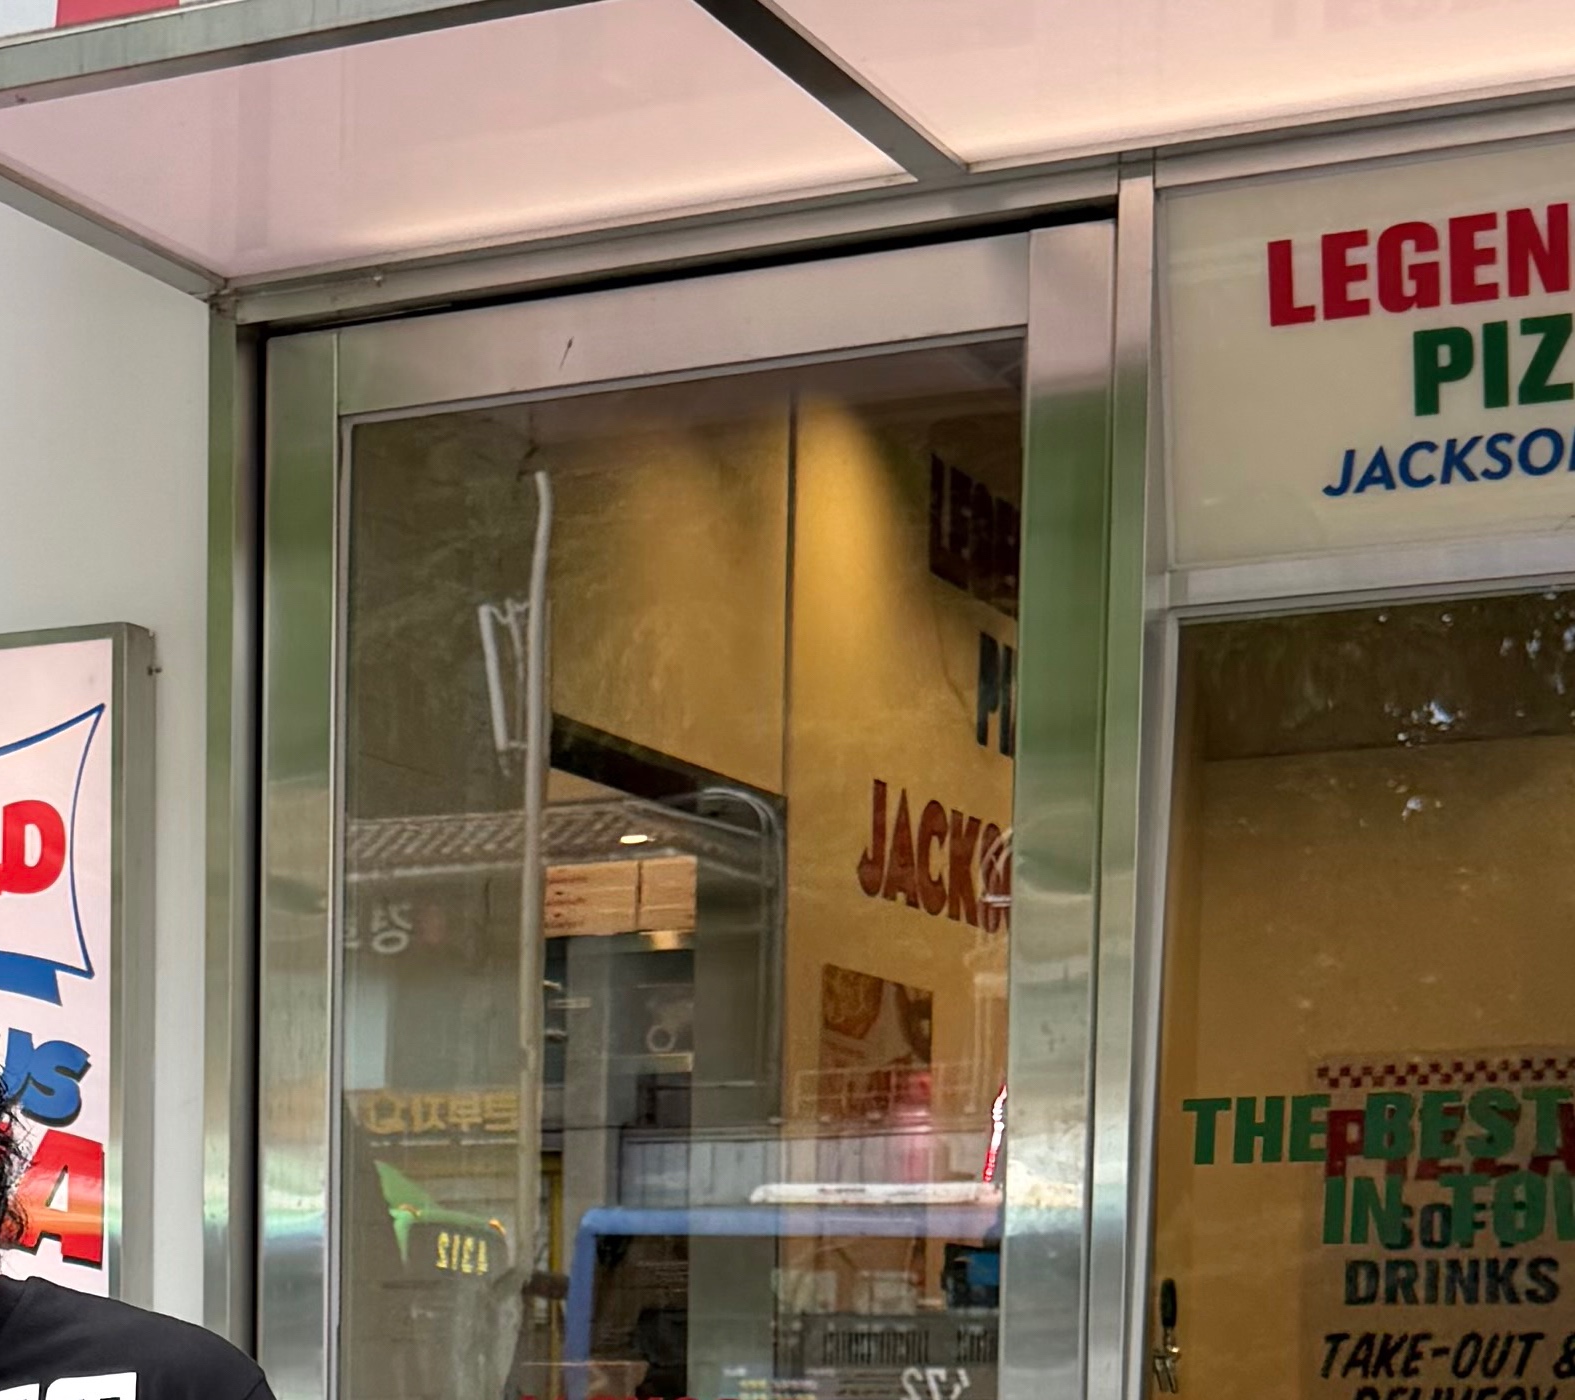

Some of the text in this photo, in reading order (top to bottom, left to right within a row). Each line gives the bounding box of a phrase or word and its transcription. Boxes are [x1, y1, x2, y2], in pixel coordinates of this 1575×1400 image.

[1267, 203, 1571, 327] LEGEN
[1411, 313, 1575, 417] PIZ
[1322, 427, 1575, 497] JACKSO
[1182, 1093, 1331, 1165] THE
[1363, 1085, 1573, 1159] BEST
[1323, 1175, 1403, 1245] IN
[1343, 1256, 1561, 1307] DRINKS
[1321, 1331, 1545, 1380] TAKE-OUT
